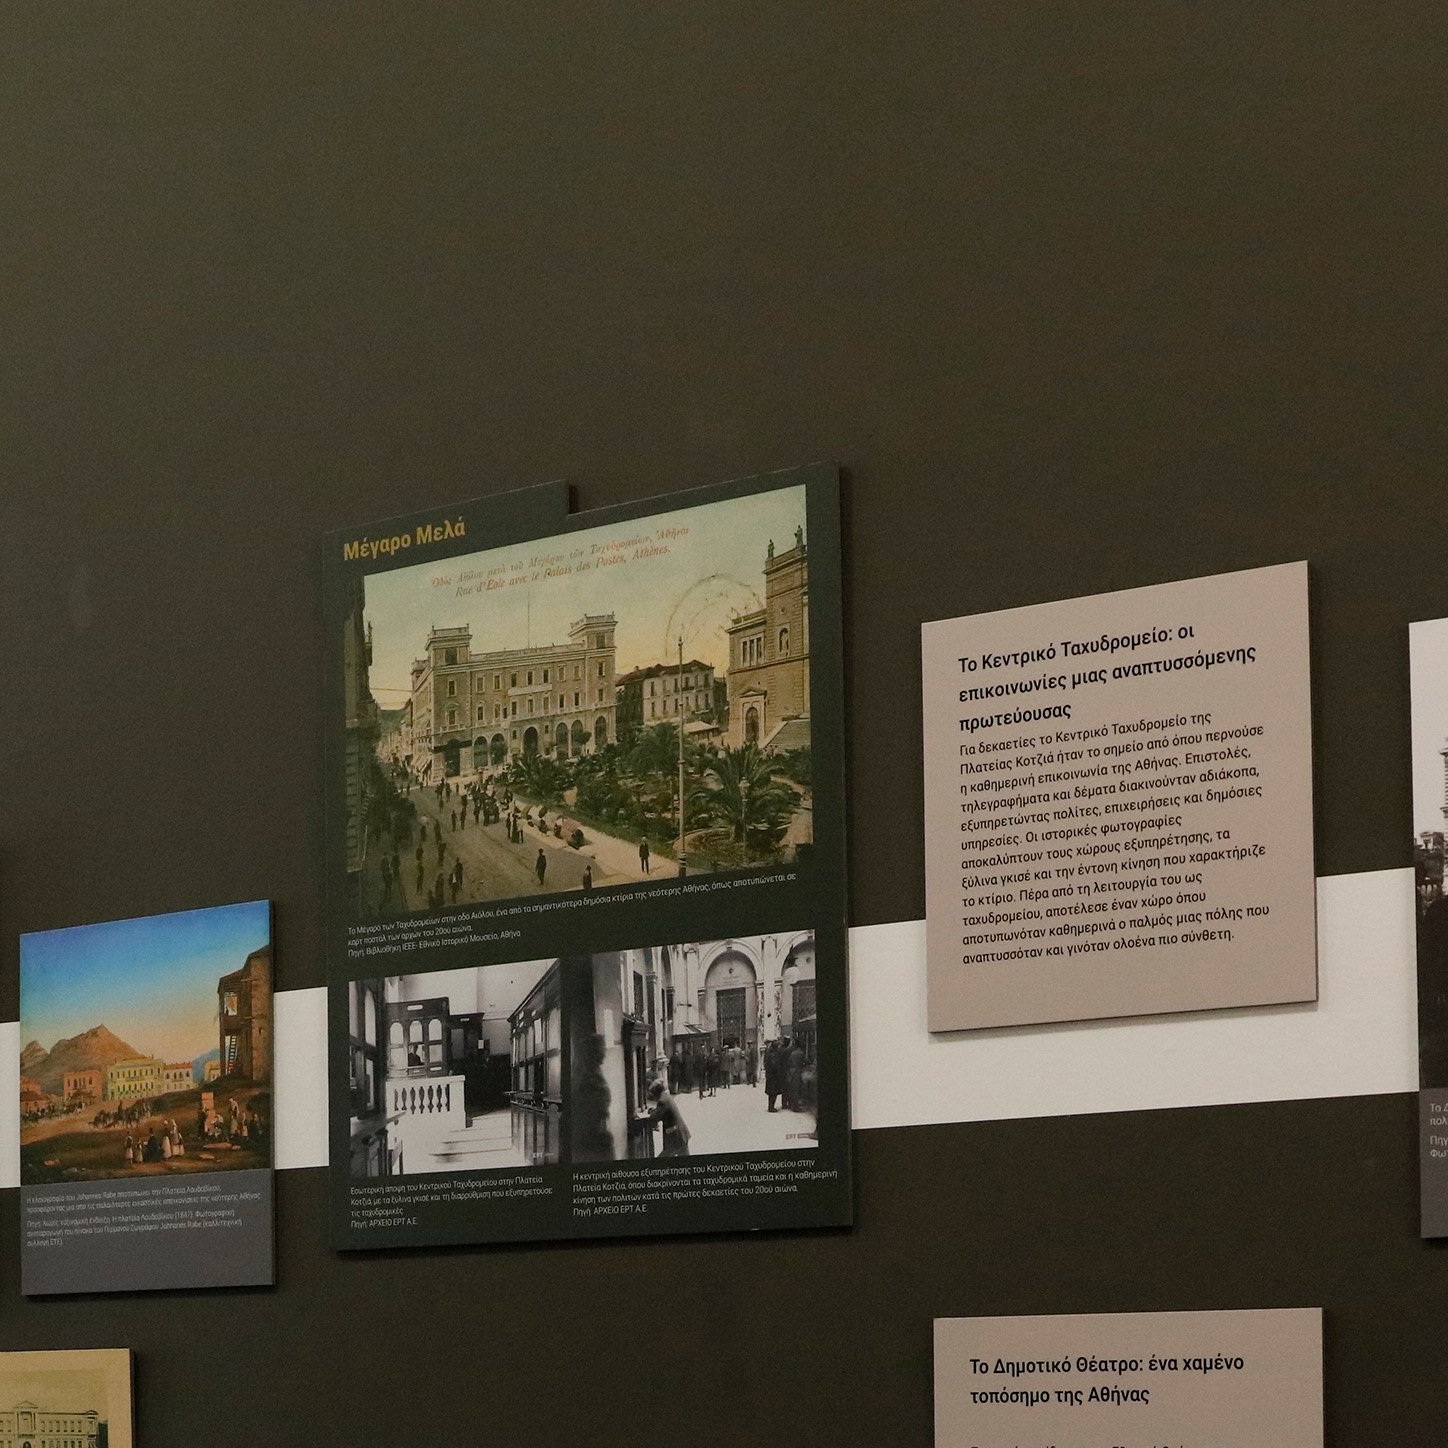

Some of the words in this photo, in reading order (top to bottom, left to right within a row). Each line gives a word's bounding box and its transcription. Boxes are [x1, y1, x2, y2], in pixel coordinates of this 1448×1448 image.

[343, 534, 411, 561] Μέγαρο
[416, 516, 466, 546] Μελά
[957, 656, 978, 673] Το
[981, 642, 1057, 670] Κεντρικό
[1060, 626, 1173, 658] Ταχυδρομείο:
[1177, 625, 1195, 640] οι
[958, 673, 1067, 703] επικοινωνίες
[1071, 668, 1108, 690] μιας
[1111, 646, 1257, 680] αναπτυσσόμενης
[958, 704, 1072, 734] πρωτεύουσας
[959, 744, 976, 757] Για
[978, 736, 1036, 754] δεκαετίες
[1038, 734, 1053, 746] το
[1055, 724, 1109, 743] Κεντρικό
[1111, 713, 1188, 735] Ταχυδρομείο
[1190, 712, 1212, 726] της
[960, 758, 1013, 775] Πλατείας
[1015, 750, 1055, 768] Κοτζιά
[1056, 749, 1084, 765] ήταν
[1086, 747, 1101, 758] το
[1103, 739, 1144, 758] σημείο
[1146, 735, 1170, 750] από
[1172, 733, 1203, 747] όπου
[1205, 724, 1264, 743] περνούσε
[960, 784, 968, 797] η
[969, 772, 1036, 793] καθημερινή
[1037, 764, 1109, 785] επικοινωνία
[1110, 762, 1132, 776] της
[1134, 756, 1182, 772] Αθήνας.
[1185, 745, 1251, 765] Επιστολές,
[969, 1358, 990, 1375] Το
[992, 1355, 1072, 1378] Δημοτικό
[1075, 1354, 1144, 1376] Θέατρο:
[1148, 1353, 1179, 1372] ένα
[1182, 1352, 1245, 1375] χαμένο
[969, 1385, 1051, 1408] τοπόσημο
[1053, 1389, 1084, 1407] της
[1087, 1384, 1150, 1407] Αθήνας
